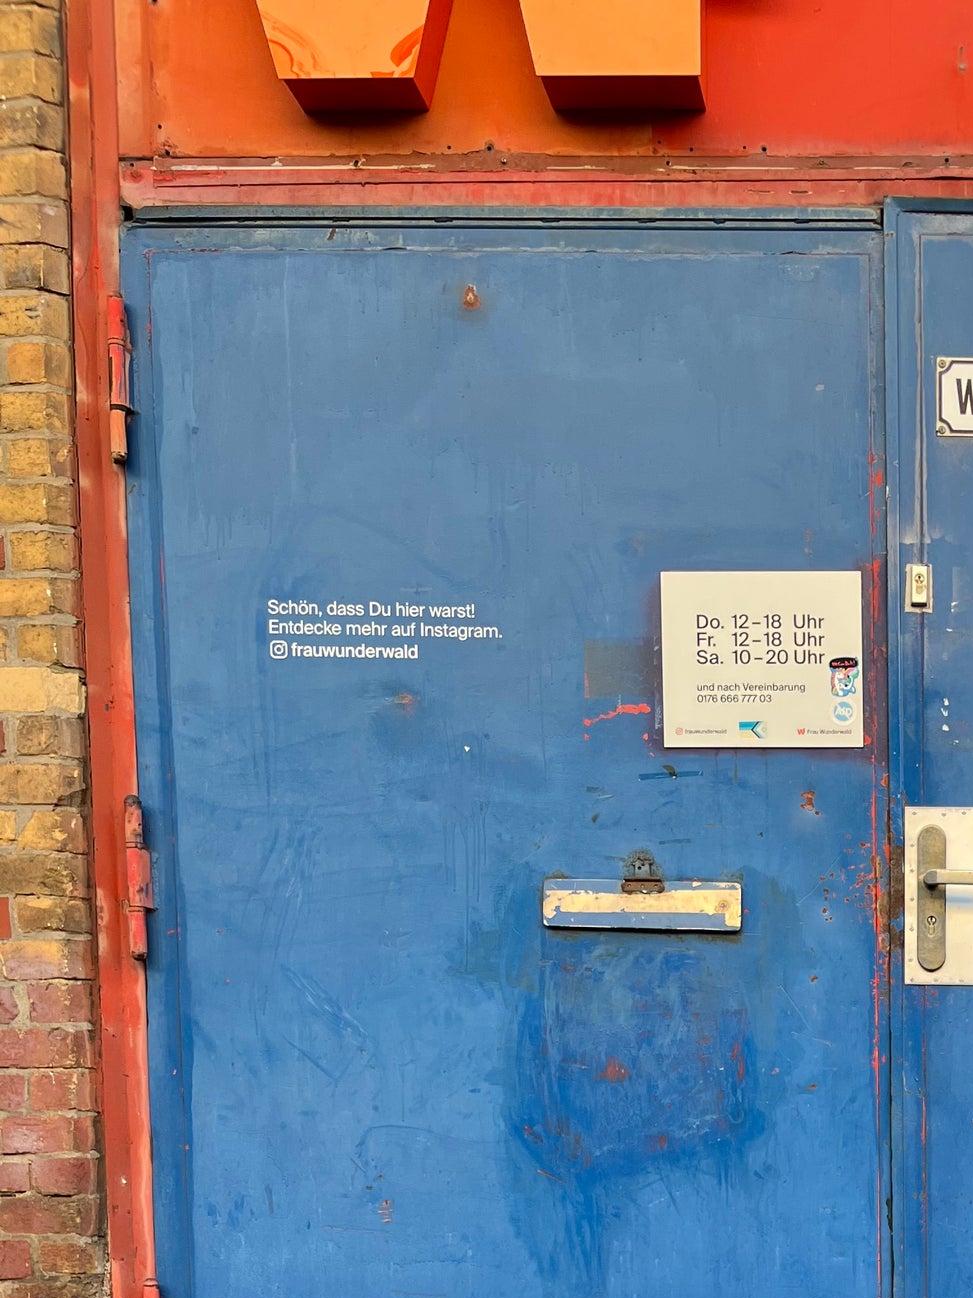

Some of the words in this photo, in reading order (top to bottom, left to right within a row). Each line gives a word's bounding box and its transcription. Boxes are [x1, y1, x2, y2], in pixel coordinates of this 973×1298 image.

[267, 599, 323, 618] Schön,
[326, 601, 364, 617] dass
[369, 602, 391, 617] Du
[396, 602, 424, 618] hier
[429, 604, 475, 619] warst!
[696, 614, 725, 629] Do.
[793, 614, 825, 629] Uhr
[268, 619, 341, 636] Entdecke
[346, 621, 387, 637] mehr
[391, 622, 416, 637] auf
[420, 622, 503, 641] Instagram.
[696, 632, 716, 647] Fr.
[794, 632, 825, 647] Uhr
[291, 642, 419, 659] frauwunderwald
[696, 650, 724, 665] Sa.
[794, 650, 825, 665] Uhr
[697, 683, 715, 692] und
[717, 683, 740, 692] nach
[743, 683, 806, 693] Vereinbarung
[697, 694, 718, 703] 0176
[720, 694, 739, 703] 666
[741, 694, 757, 703] 777
[759, 694, 772, 703] 03
